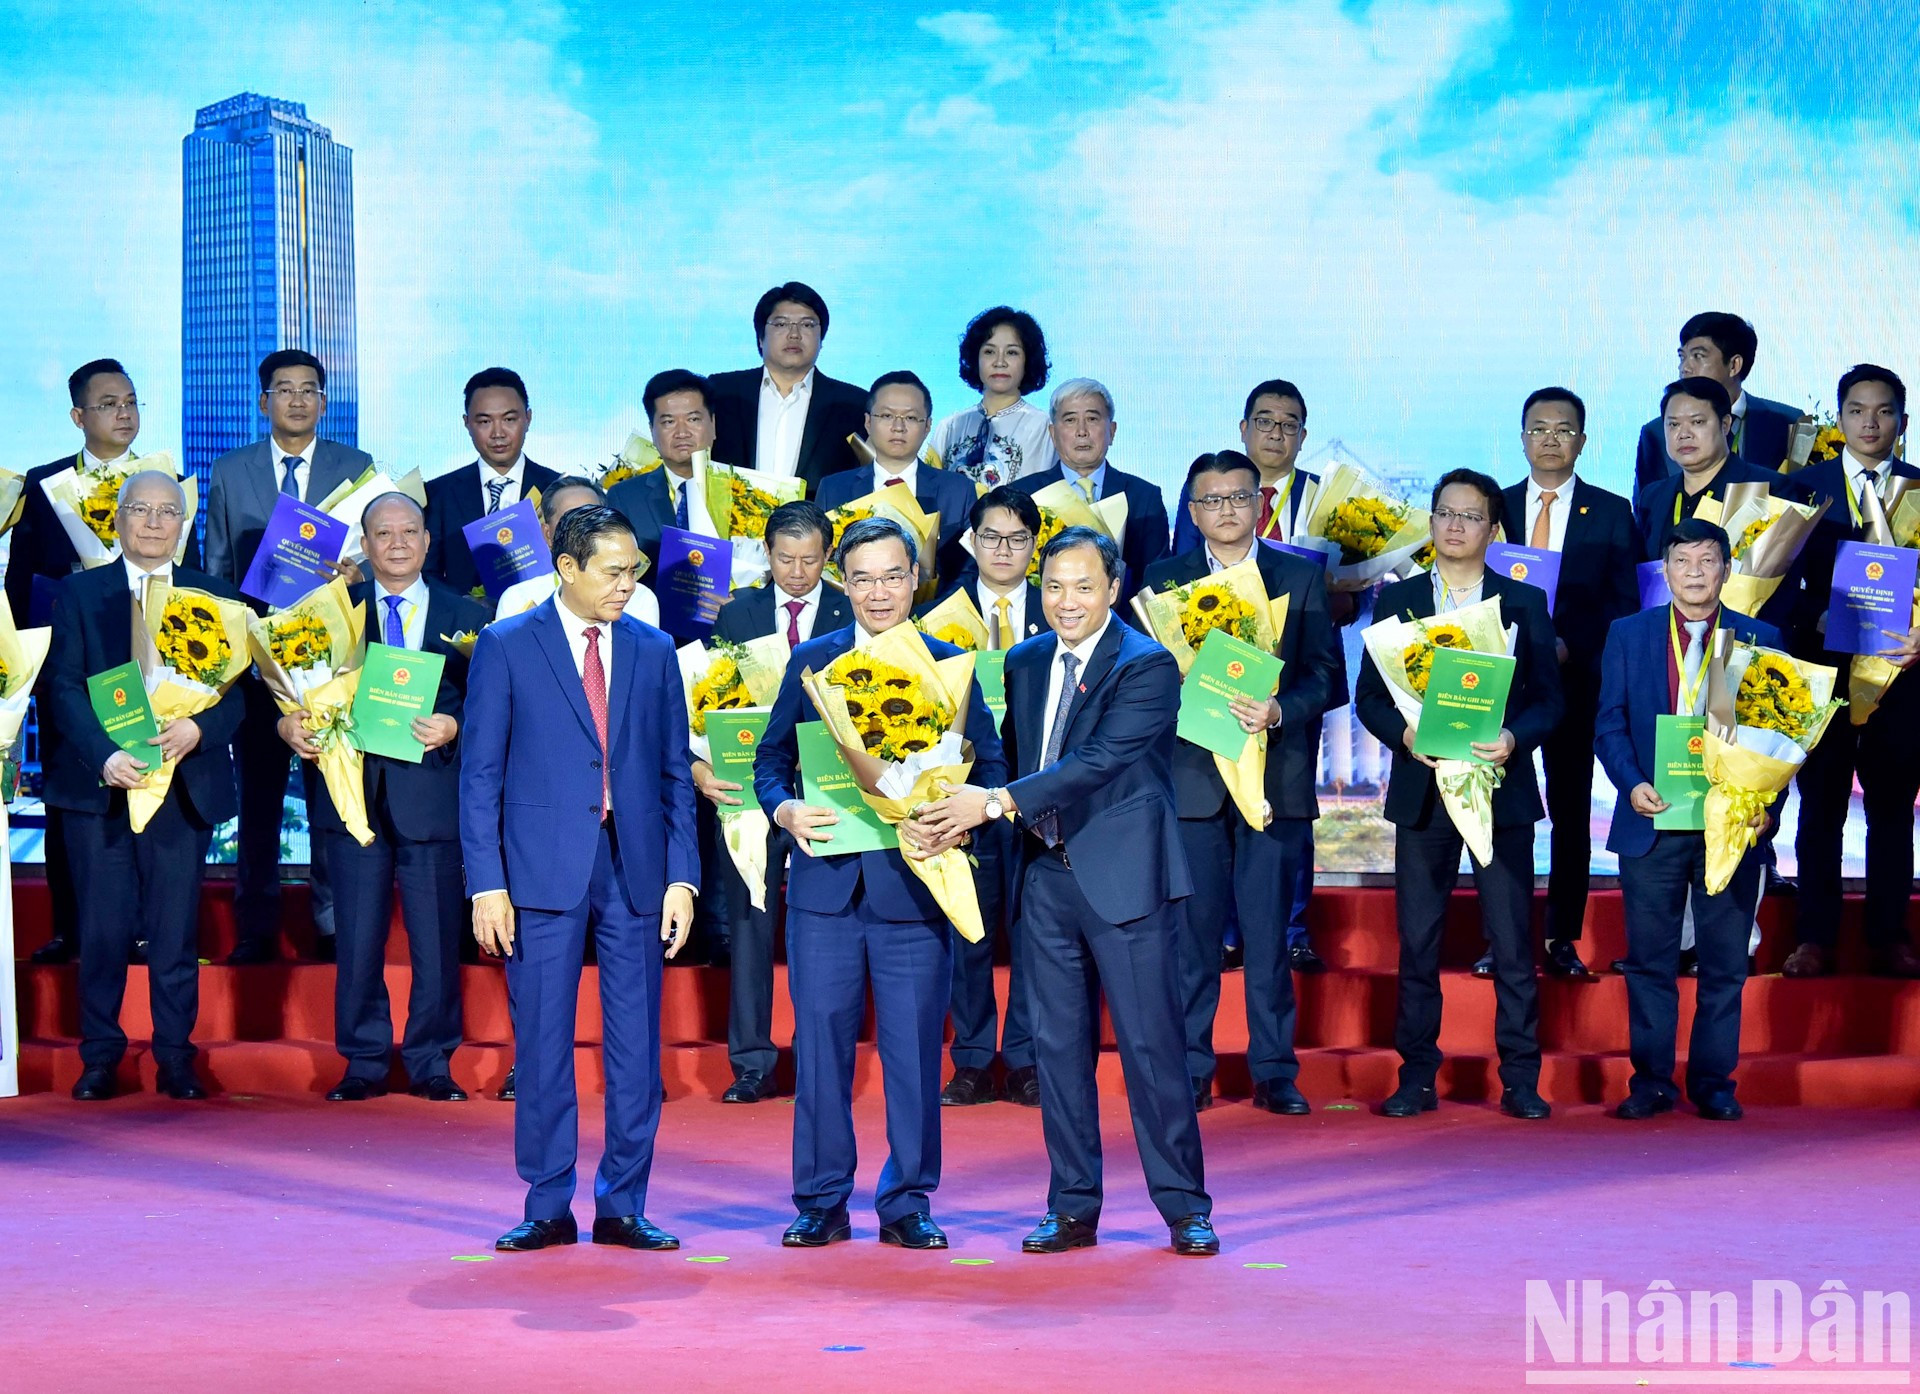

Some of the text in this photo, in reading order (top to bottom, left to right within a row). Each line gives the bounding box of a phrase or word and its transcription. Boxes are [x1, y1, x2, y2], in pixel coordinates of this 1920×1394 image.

[1850, 585, 1875, 594] QUYẾT
[1667, 761, 1682, 769] BIÊN
[816, 774, 834, 783] BIÊN
